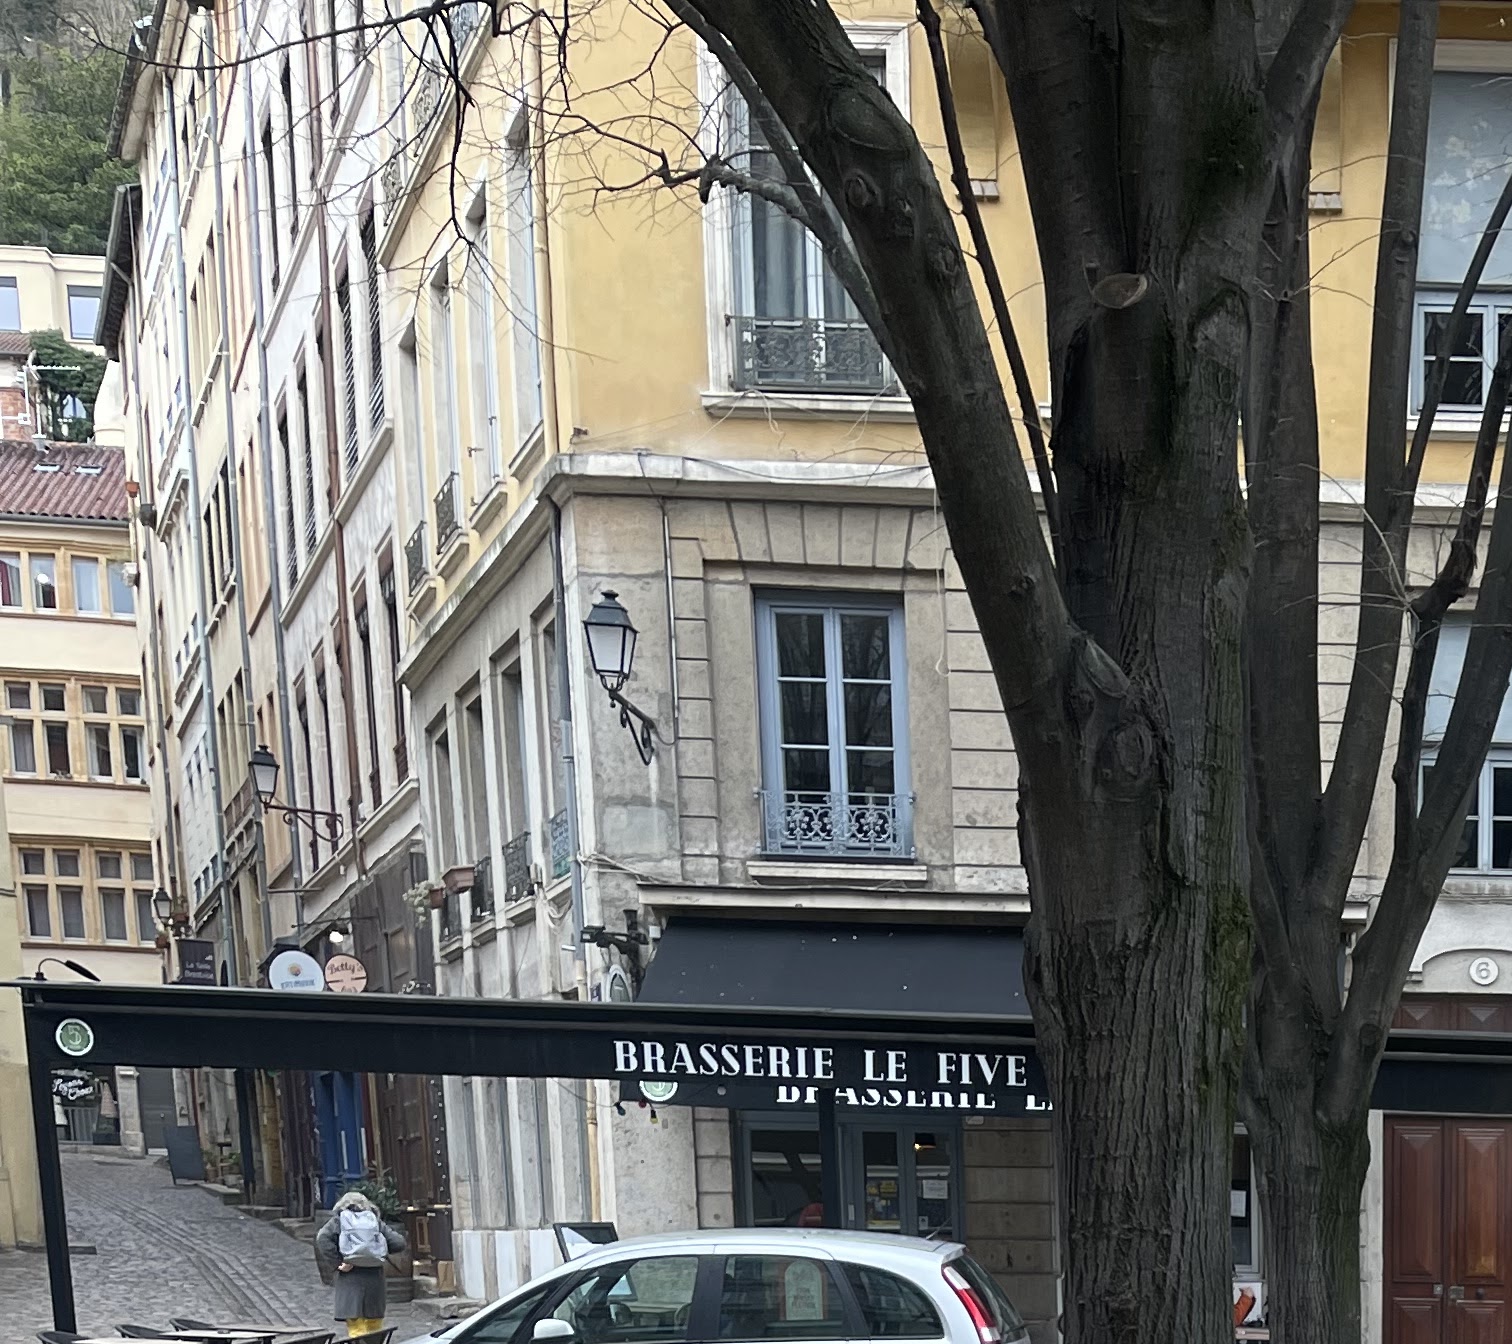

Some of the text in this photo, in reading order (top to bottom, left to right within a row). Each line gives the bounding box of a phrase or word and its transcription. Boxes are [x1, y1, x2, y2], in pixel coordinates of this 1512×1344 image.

[1475, 961, 1491, 980] 6
[612, 1040, 1027, 1087] BRASSERIE LE FIVE
